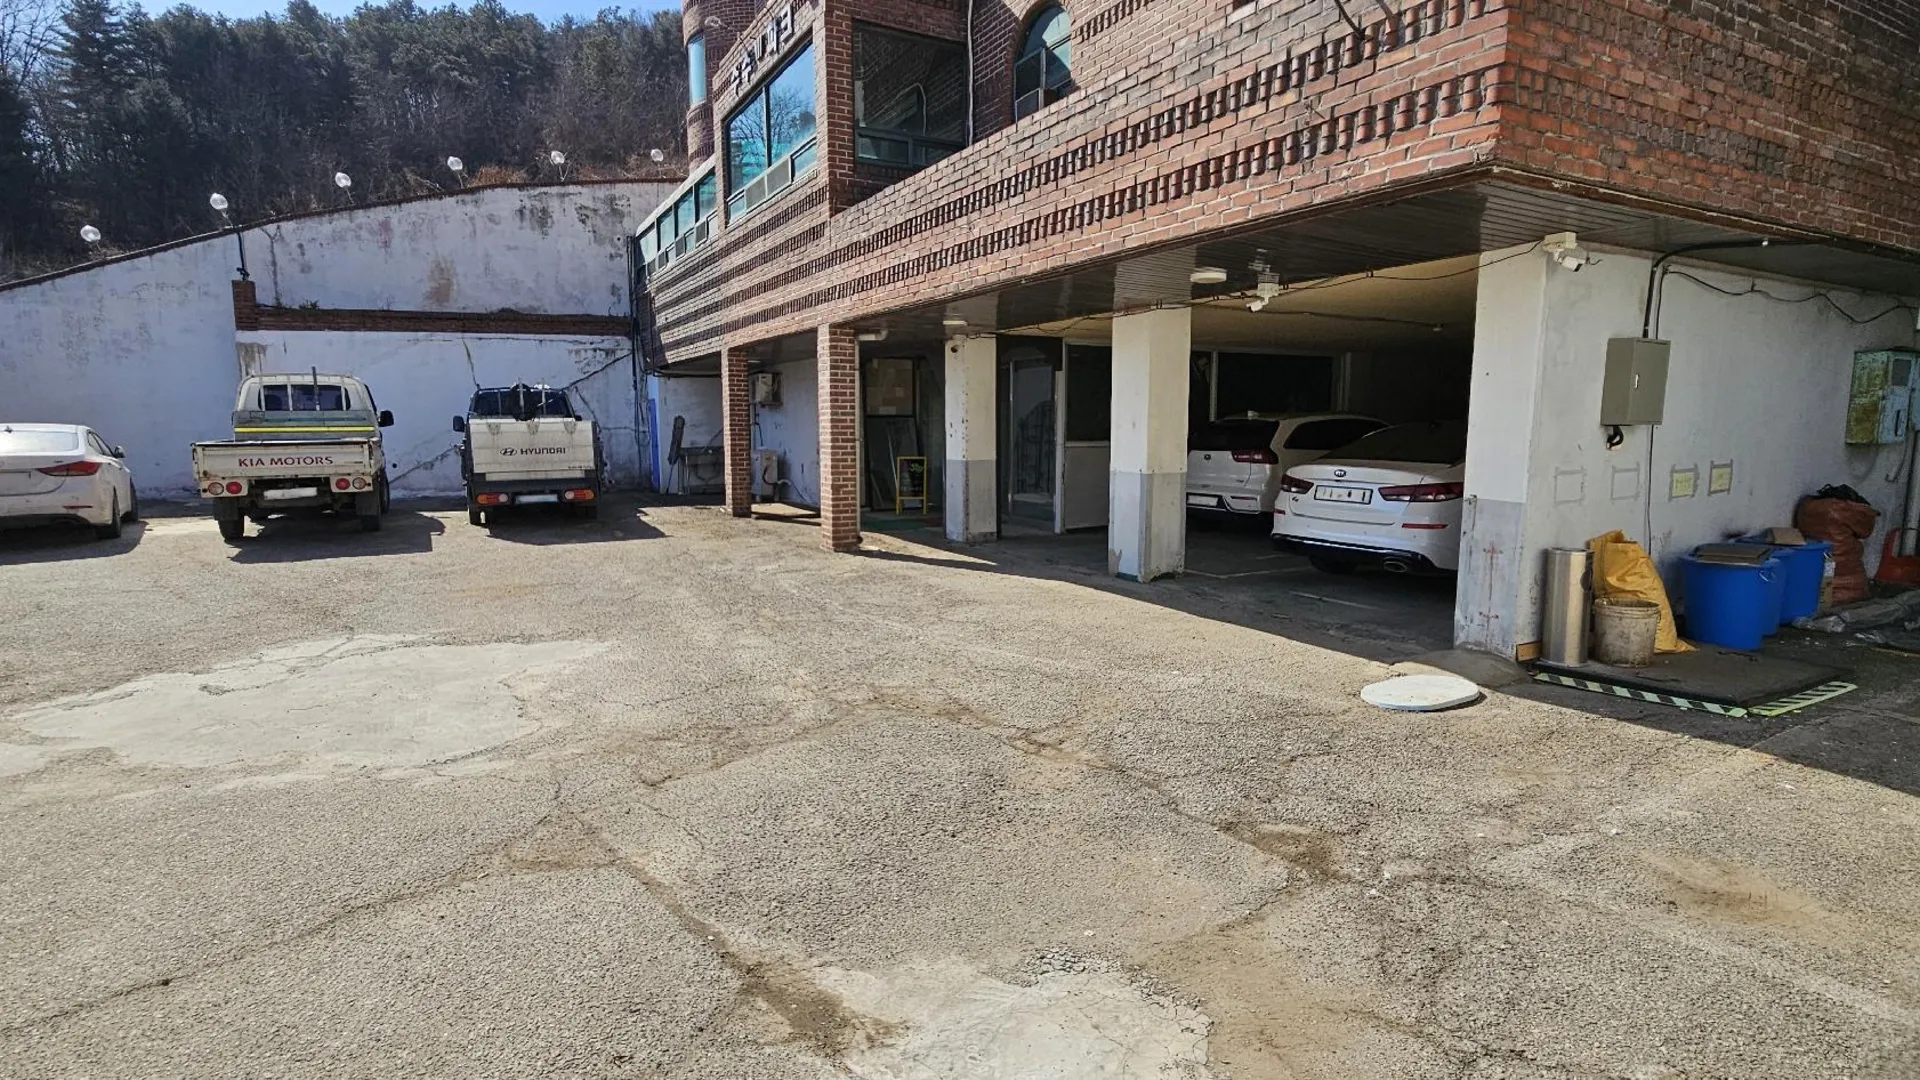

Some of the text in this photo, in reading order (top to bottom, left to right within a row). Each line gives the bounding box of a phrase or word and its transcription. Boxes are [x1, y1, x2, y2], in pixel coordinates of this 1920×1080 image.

[520, 447, 566, 455] HYUNDAI
[238, 456, 333, 467] KIA MOTORS
